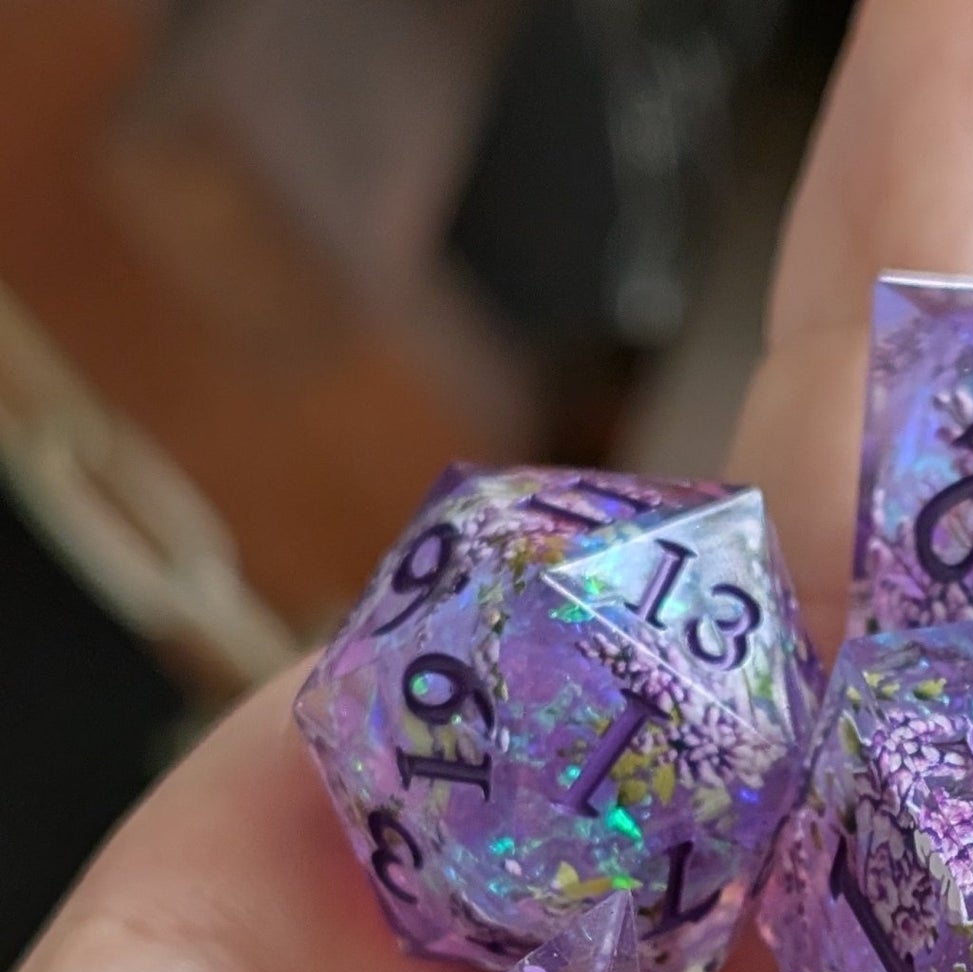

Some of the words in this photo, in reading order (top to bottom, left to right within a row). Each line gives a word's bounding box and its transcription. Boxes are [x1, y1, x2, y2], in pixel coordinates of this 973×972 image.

[624, 537, 763, 672] 13
[397, 651, 497, 802] 19
[548, 688, 674, 819] 1
